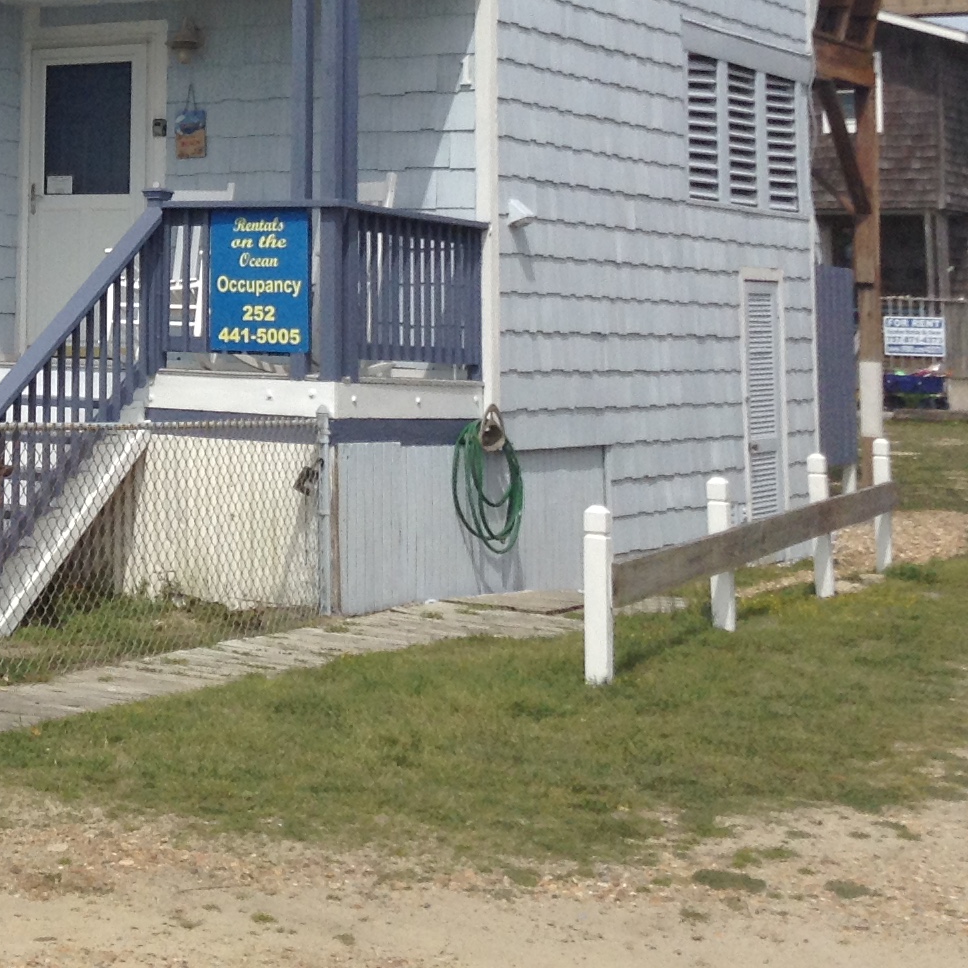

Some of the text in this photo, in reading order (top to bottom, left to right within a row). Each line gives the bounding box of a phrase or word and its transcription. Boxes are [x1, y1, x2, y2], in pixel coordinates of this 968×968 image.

[233, 217, 284, 232] Rentals
[231, 233, 287, 249] on the
[239, 252, 279, 268] Ocean
[216, 275, 302, 298] Occupancy
[242, 305, 276, 322] 252
[218, 326, 302, 345] 441-5005
